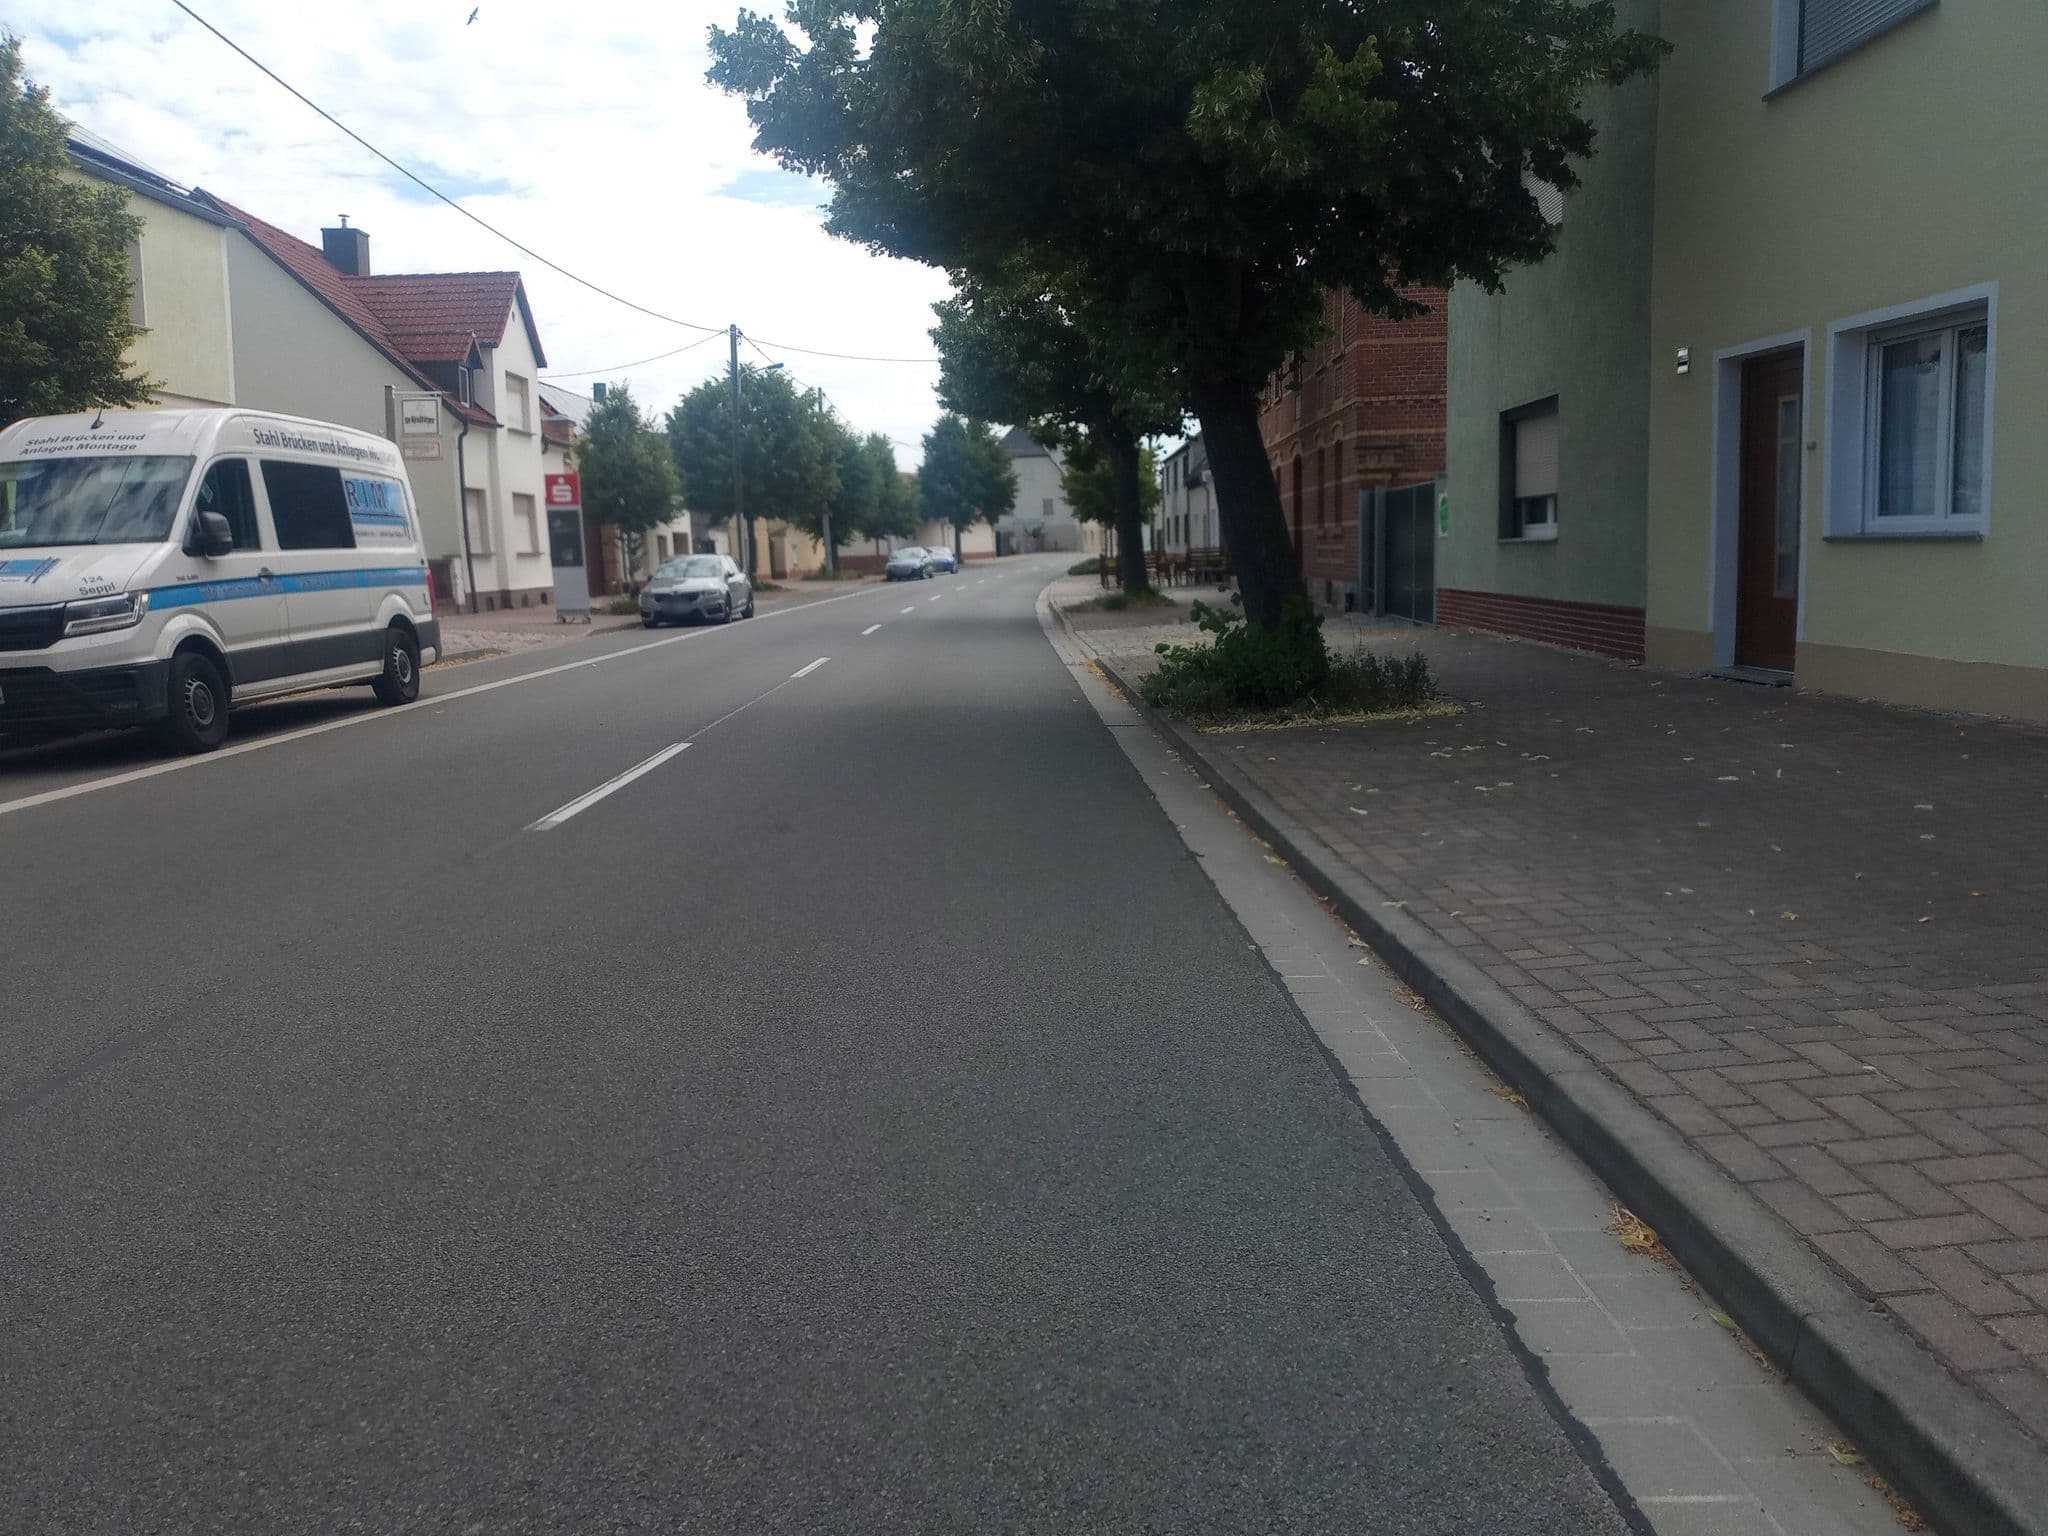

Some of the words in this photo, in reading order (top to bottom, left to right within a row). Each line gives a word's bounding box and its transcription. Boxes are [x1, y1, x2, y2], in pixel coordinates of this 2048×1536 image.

[25, 437, 59, 447] Stahl
[60, 433, 114, 442] Brücken
[253, 428, 280, 446] Stahl
[280, 432, 319, 451] Brücken
[319, 439, 336, 454] und
[20, 444, 73, 455] Anlagen
[76, 443, 137, 451] Montage
